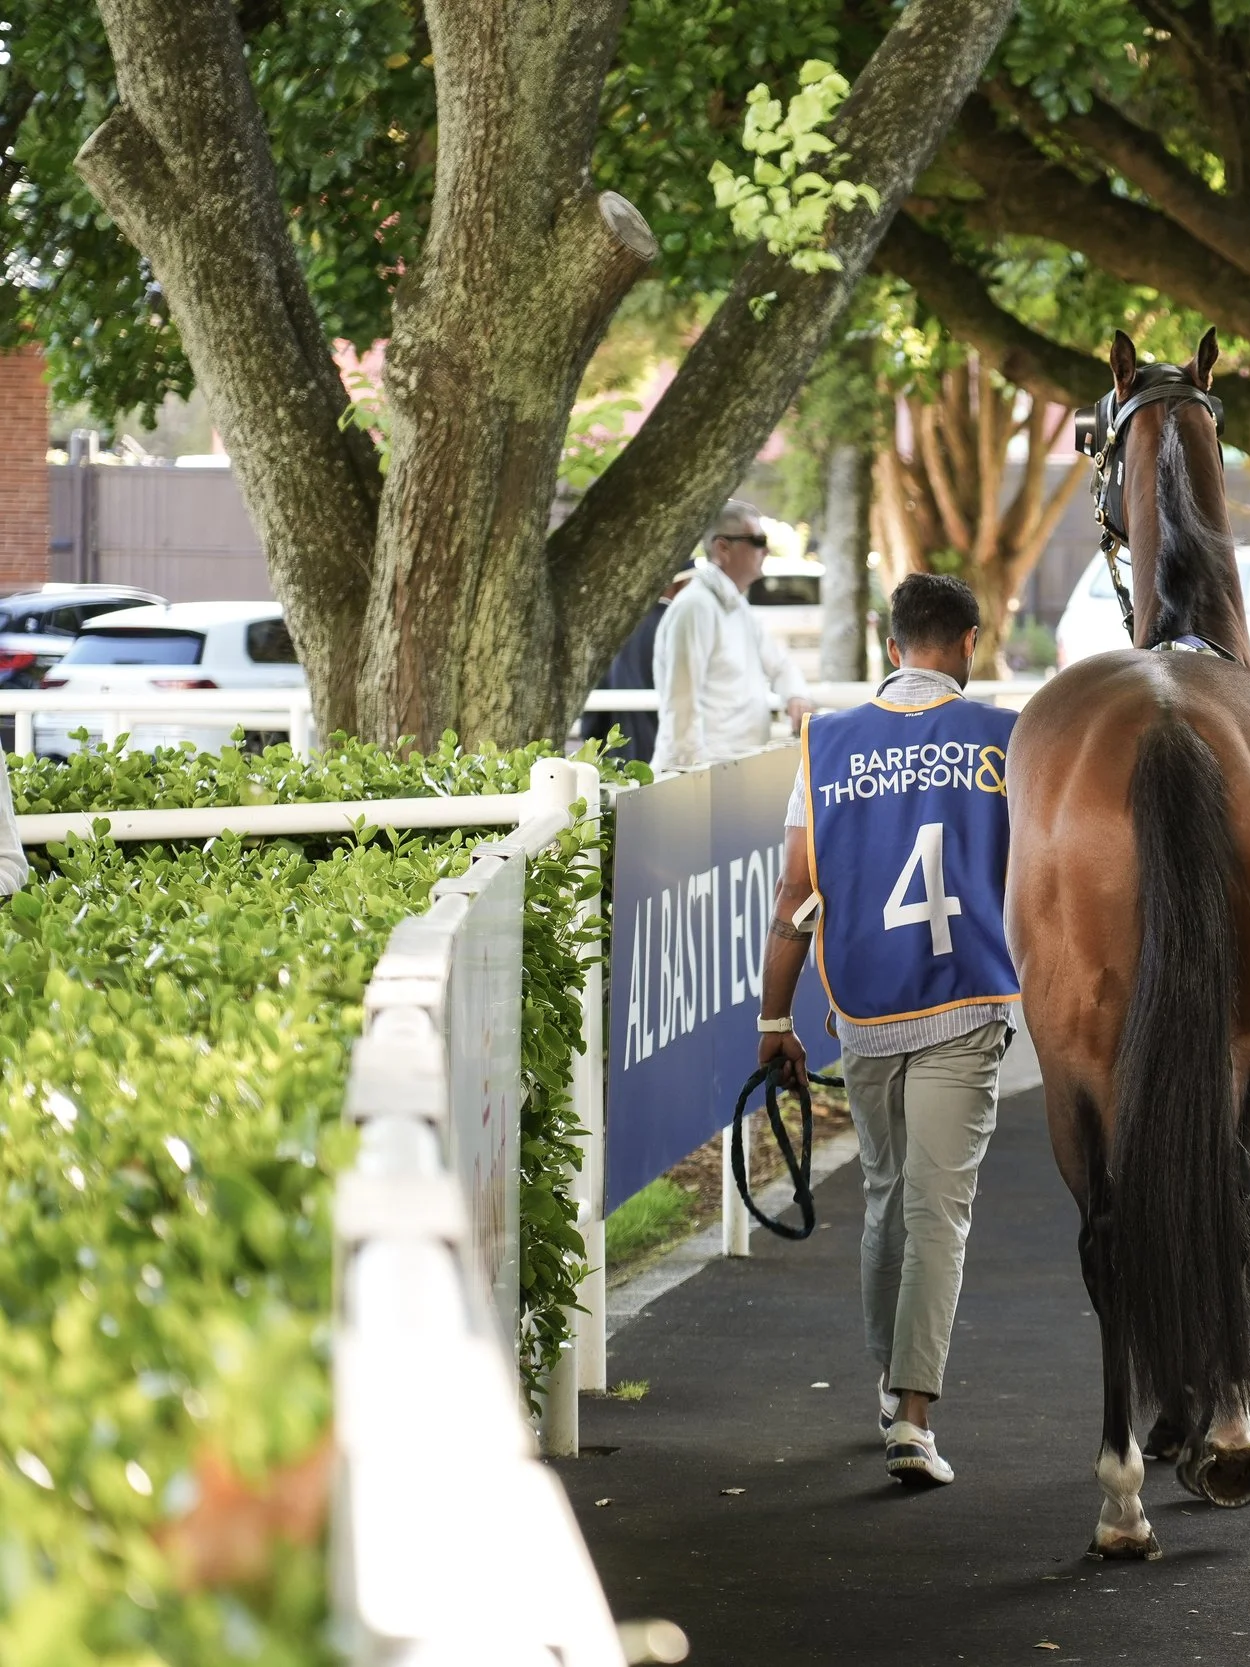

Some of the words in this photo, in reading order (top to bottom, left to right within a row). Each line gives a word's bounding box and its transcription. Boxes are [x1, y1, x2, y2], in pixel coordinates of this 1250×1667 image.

[818, 764, 972, 807] THOMPSON
[850, 741, 980, 776] BARFOOT
[883, 822, 962, 956] 4
[624, 896, 654, 1072] AL
[659, 866, 721, 1049] BASTI
